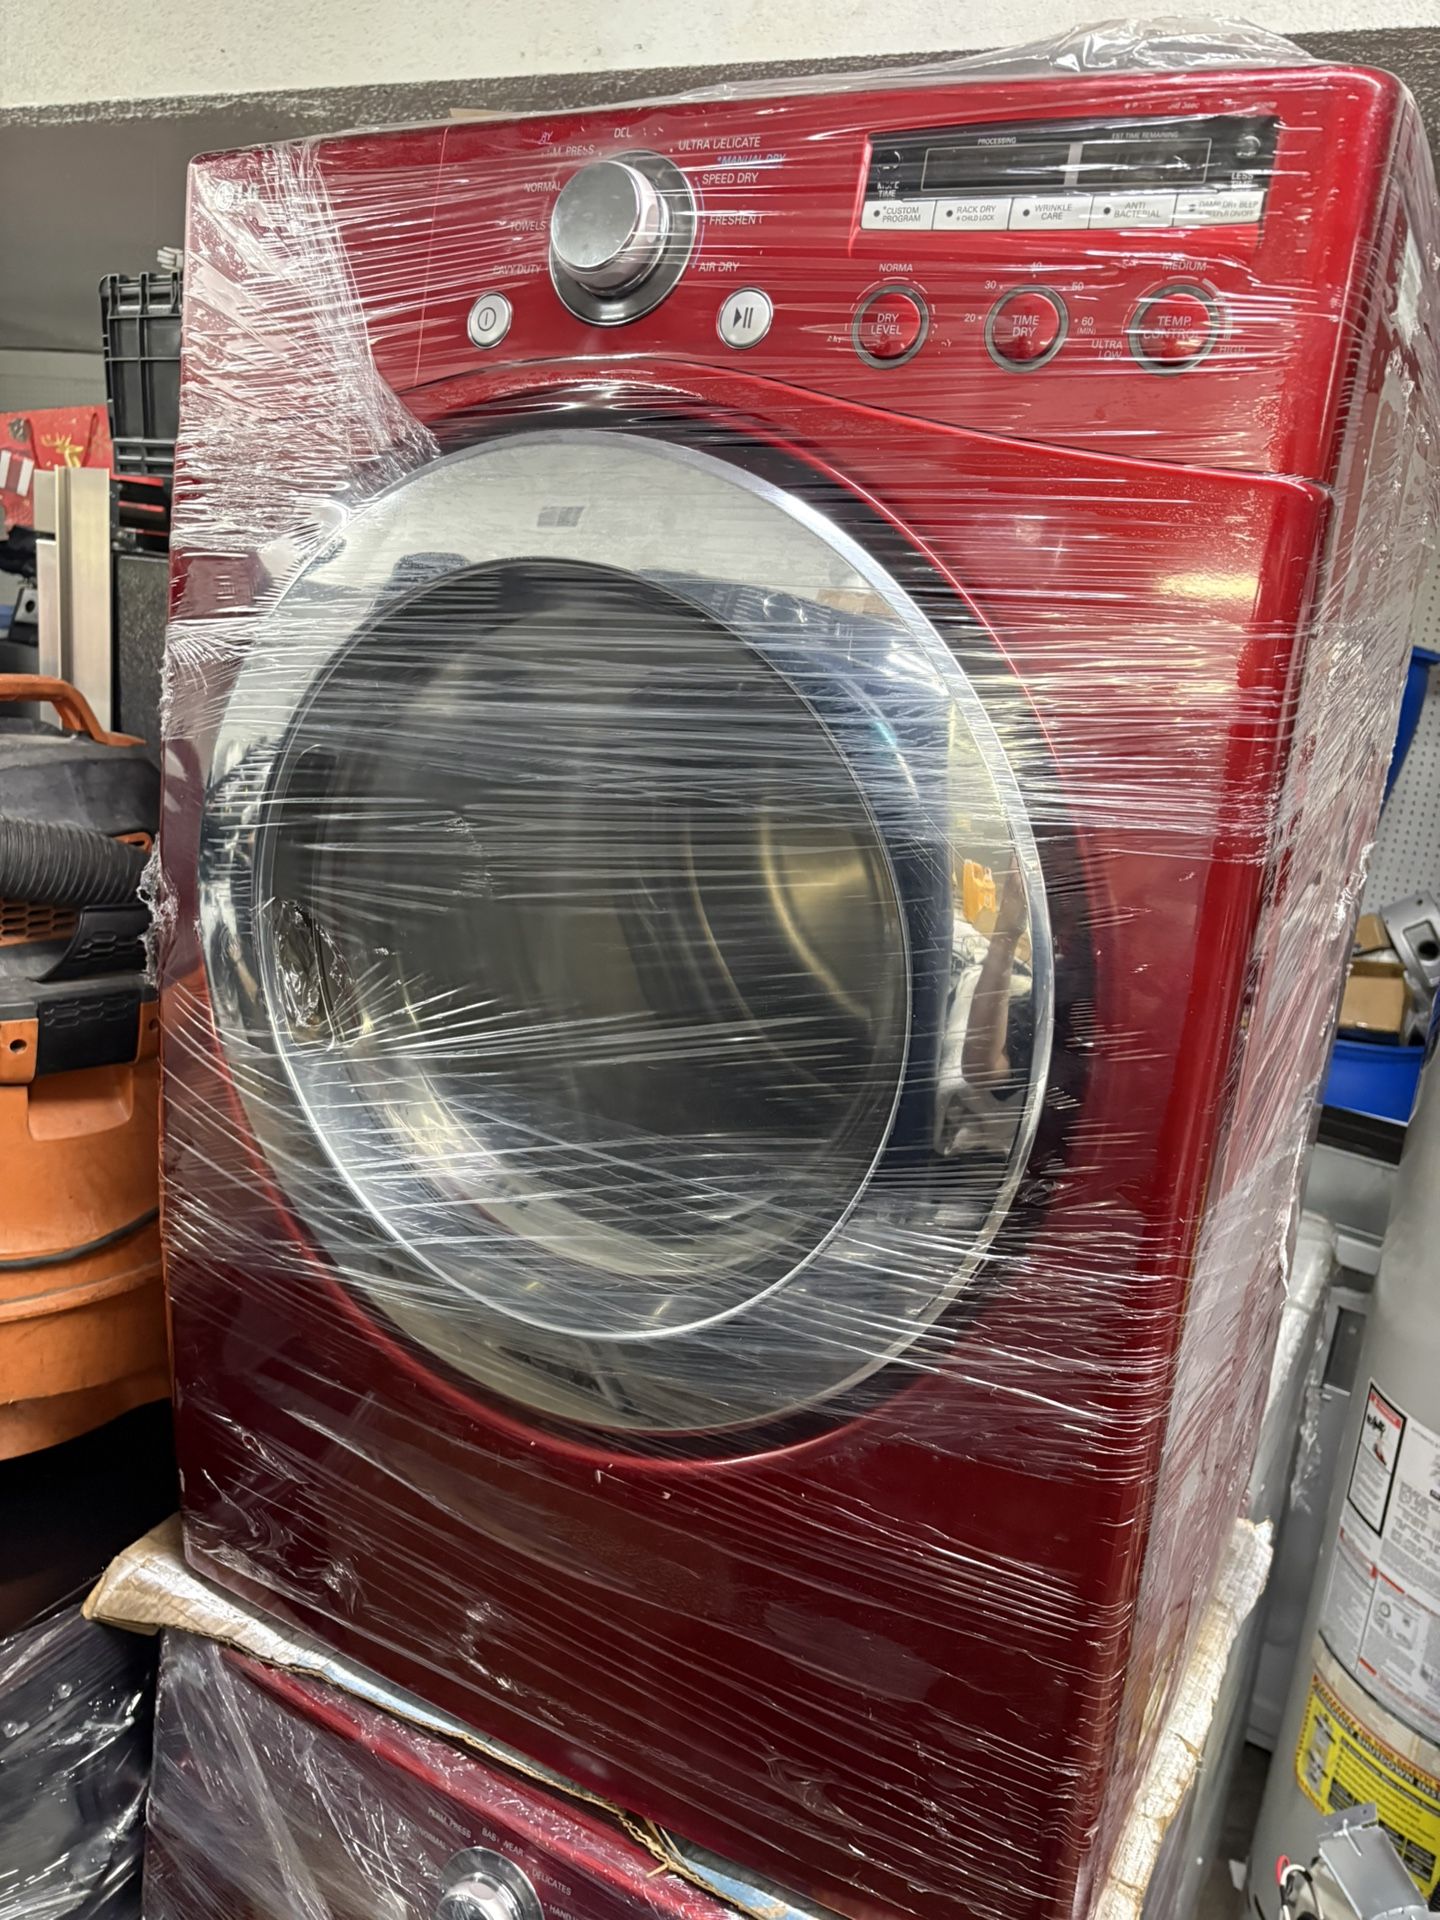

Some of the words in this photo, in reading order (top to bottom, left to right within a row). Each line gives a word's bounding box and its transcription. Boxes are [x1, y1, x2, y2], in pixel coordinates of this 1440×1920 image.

[678, 139, 710, 151] ULTRA
[713, 136, 761, 149] DELICATE
[977, 136, 1017, 146] PROCESSING
[702, 173, 734, 185] SPEED
[737, 172, 759, 184] DRY
[523, 180, 562, 193] NORMAL
[878, 189, 897, 198] TIME
[956, 206, 978, 214] RACK
[980, 205, 996, 214] DRY
[1035, 204, 1073, 212] WRINKLE
[1125, 202, 1146, 210] ANTI
[709, 214, 756, 226] FRESHEN
[882, 214, 921, 223] PROGRAM
[961, 214, 979, 222] CHILD
[979, 213, 995, 221] LOCK
[1041, 212, 1064, 221] CARE
[510, 220, 547, 232] TOWELS
[698, 262, 716, 272] AIR
[718, 261, 740, 272] DRY
[1162, 261, 1208, 271] MEDIUM
[984, 280, 997, 290] 30
[877, 313, 900, 323] DRY
[964, 313, 976, 323] 20
[1012, 314, 1040, 326] TIME
[1081, 316, 1094, 327] 60
[871, 324, 902, 335] LEVEL
[1012, 326, 1036, 337] DRY
[1091, 339, 1123, 350] ULTRA
[1098, 350, 1123, 360] LOW
[532, 1868, 572, 1897] DELICATES
